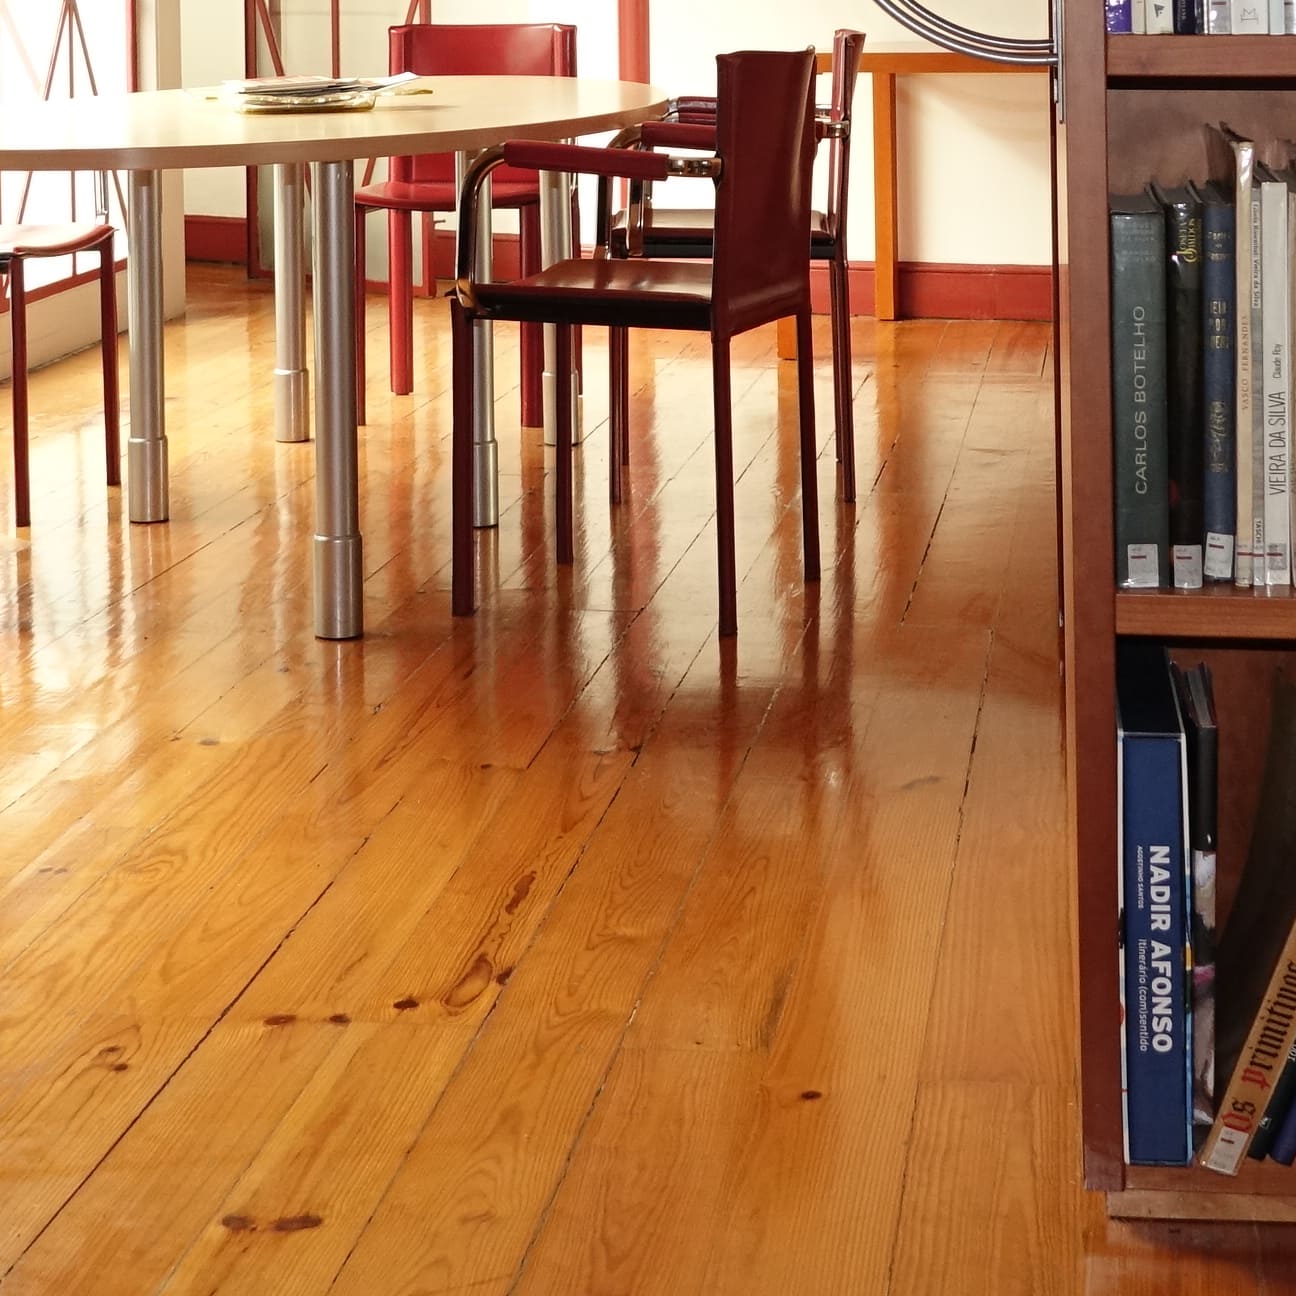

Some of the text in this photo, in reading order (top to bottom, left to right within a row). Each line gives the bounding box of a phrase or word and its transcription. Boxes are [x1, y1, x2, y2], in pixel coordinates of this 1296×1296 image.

[1132, 306, 1147, 494] CARLOS BOTELHO
[1266, 391, 1286, 495] VIEIRA DA SILVA
[1138, 938, 1149, 1052] Itinerário (com)sentido
[1149, 844, 1173, 1053] NADIR AFONSO
